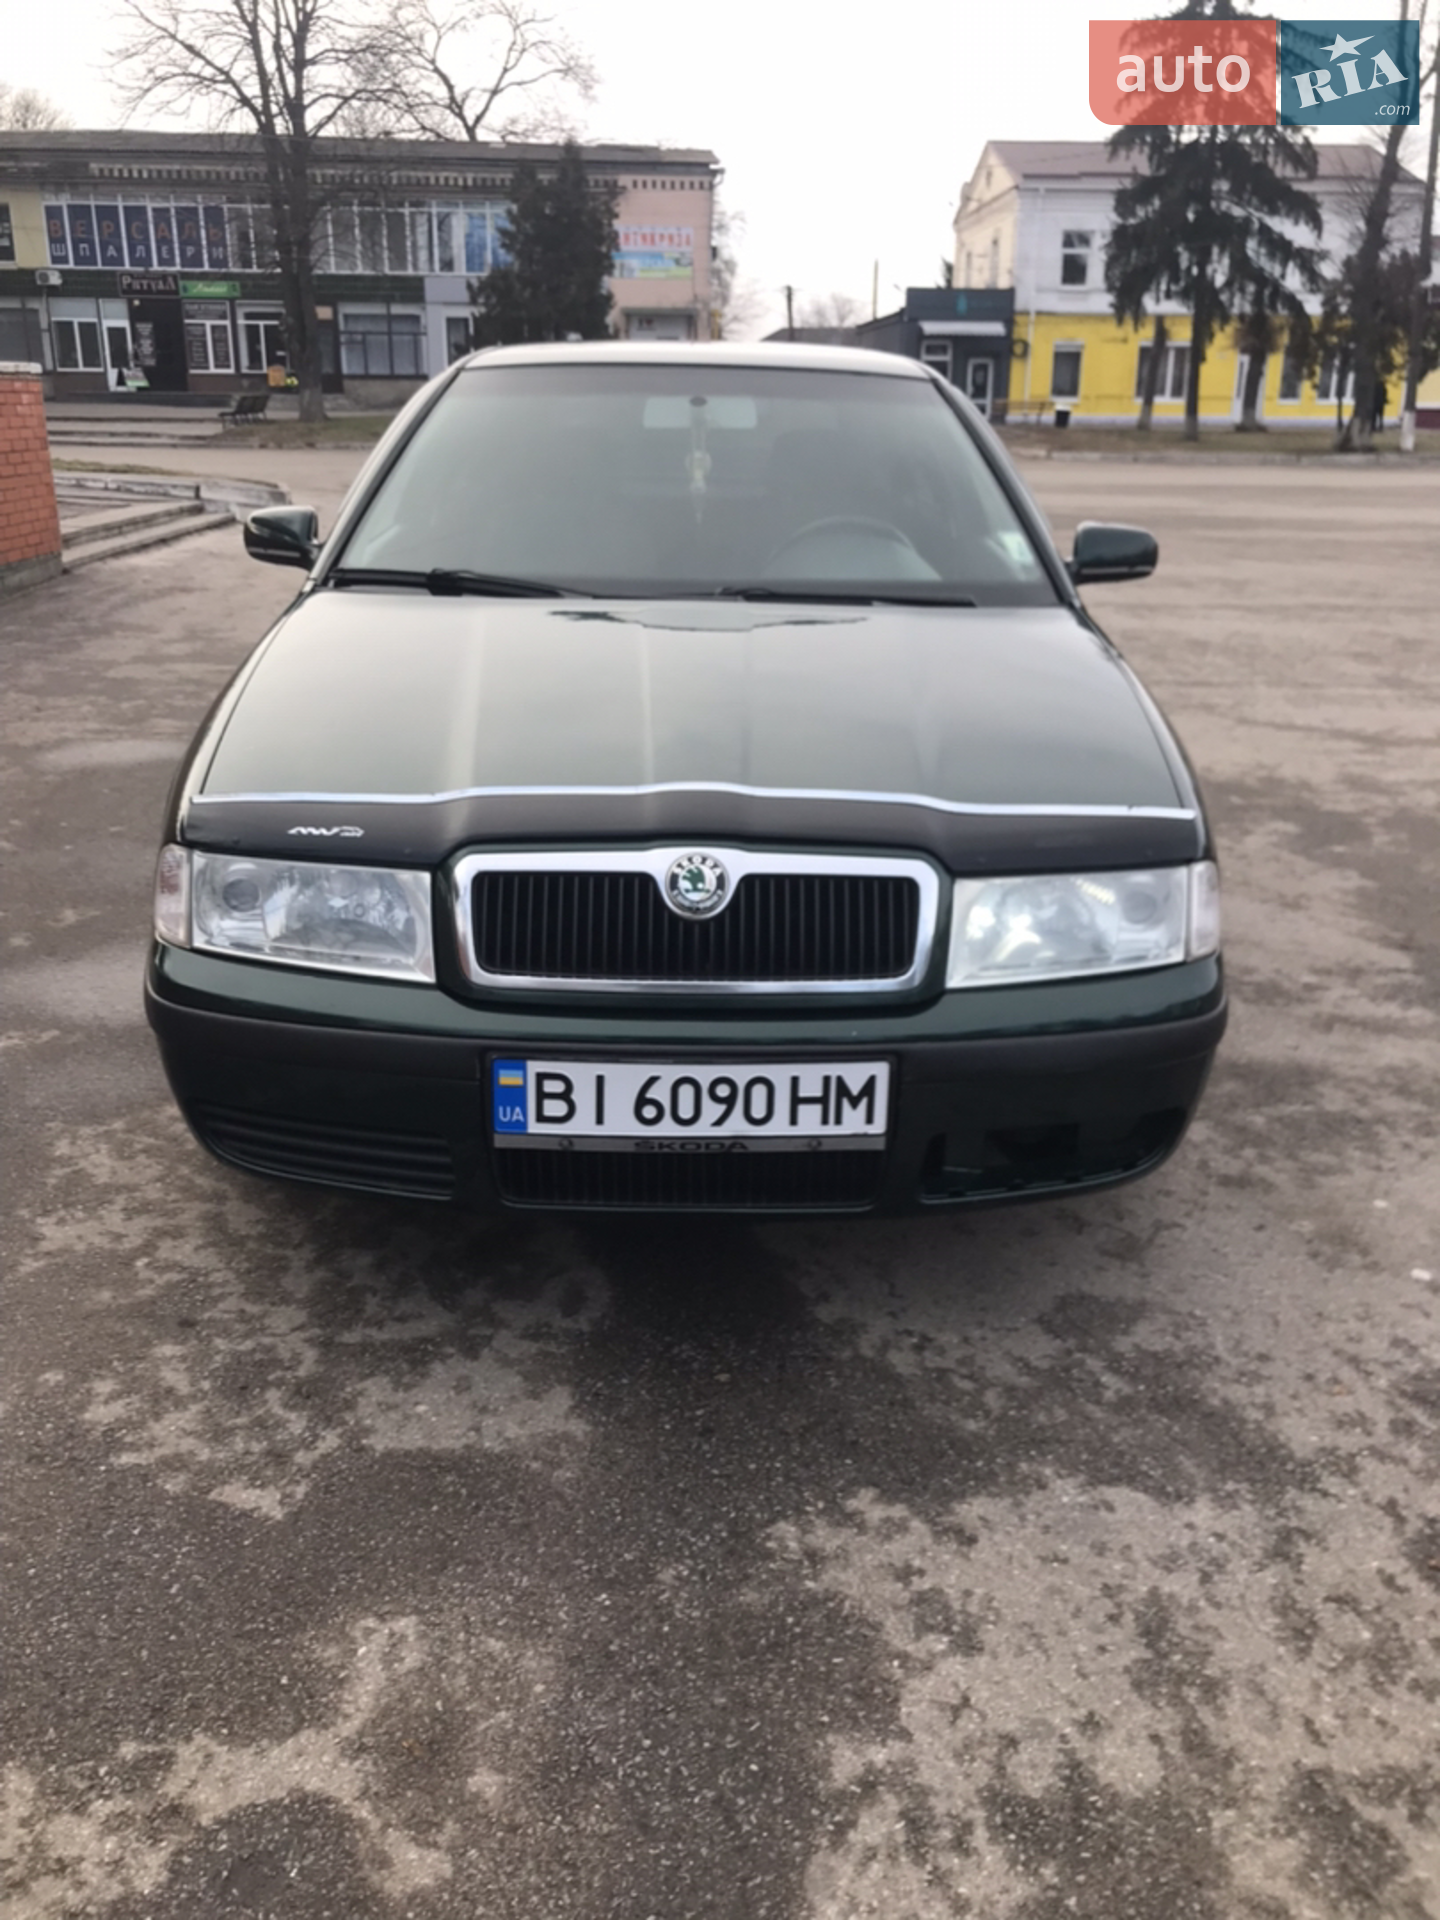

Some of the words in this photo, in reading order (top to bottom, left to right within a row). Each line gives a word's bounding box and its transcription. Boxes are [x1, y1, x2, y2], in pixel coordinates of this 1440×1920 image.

[49, 219, 224, 241] ВЕРСАЛЬ
[51, 243, 224, 260] ШПАЛЕРИ
[498, 1106, 525, 1122] UA
